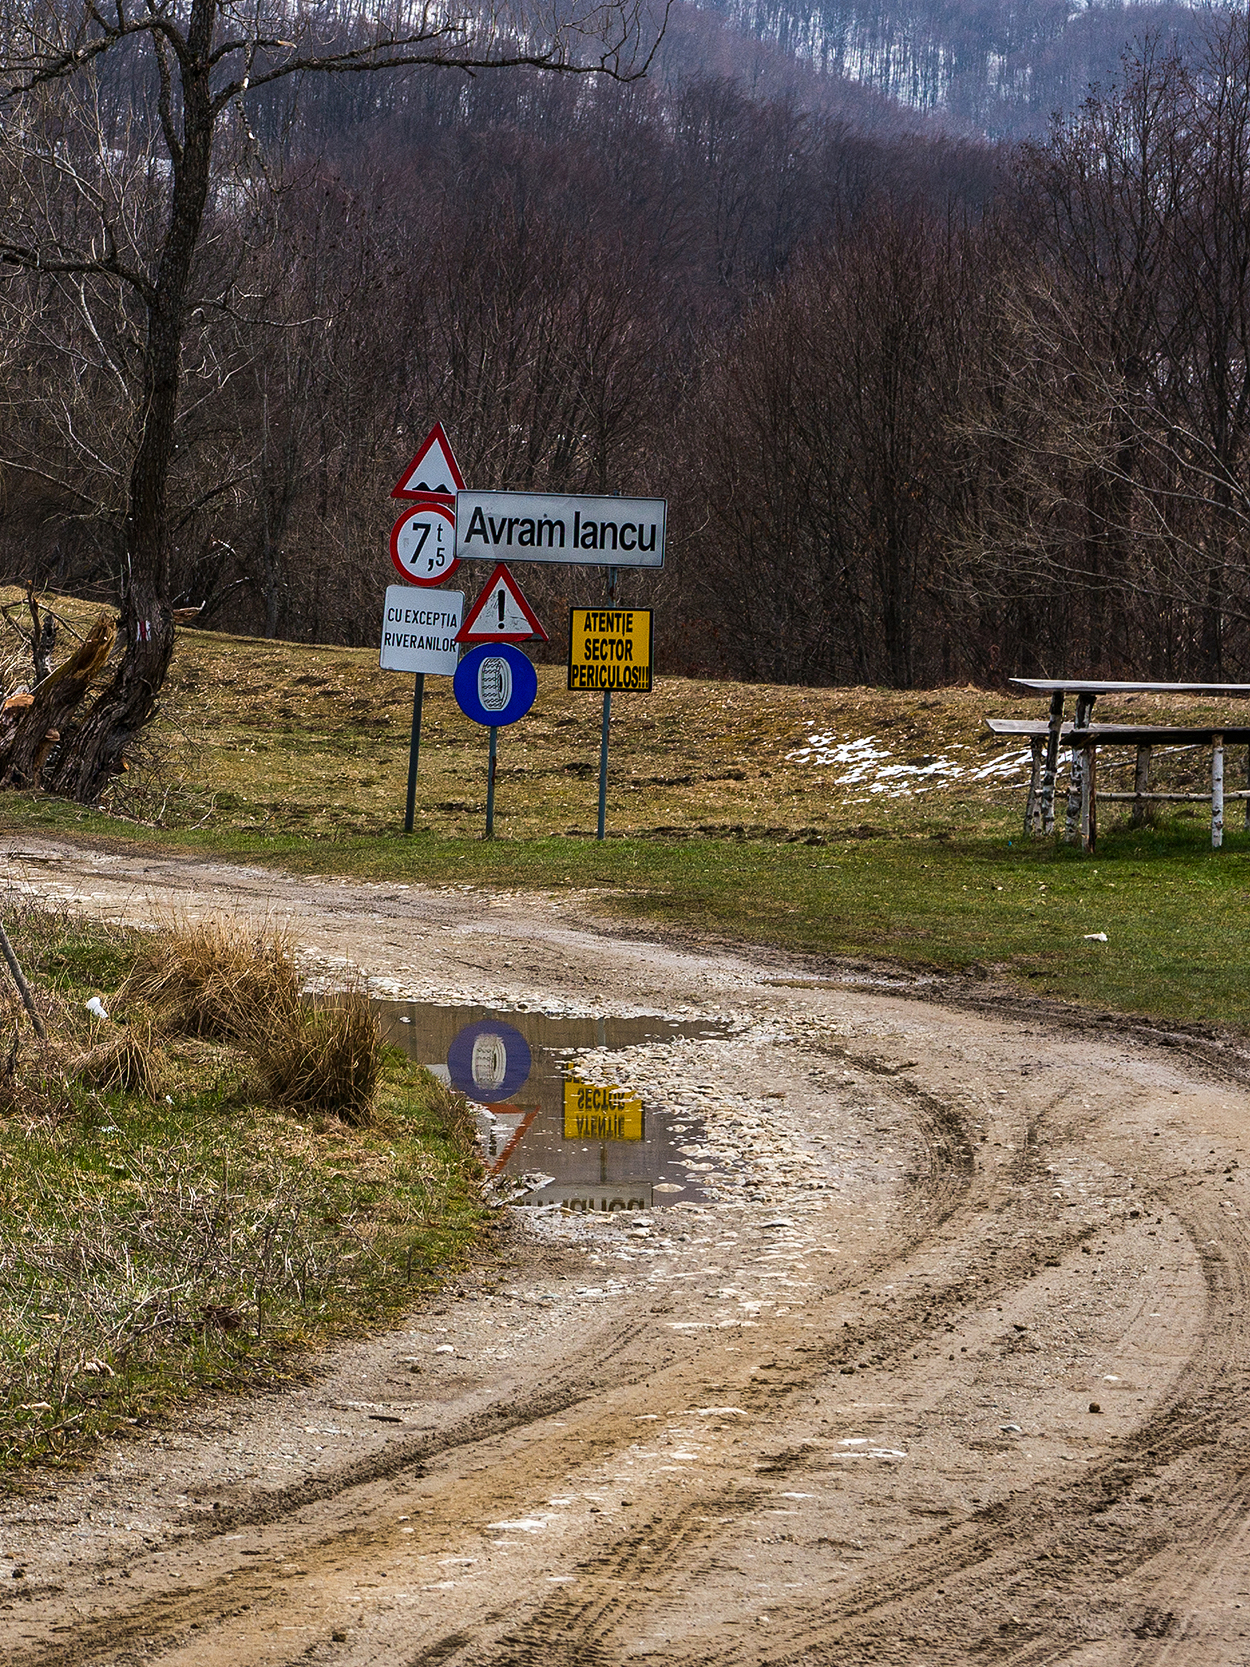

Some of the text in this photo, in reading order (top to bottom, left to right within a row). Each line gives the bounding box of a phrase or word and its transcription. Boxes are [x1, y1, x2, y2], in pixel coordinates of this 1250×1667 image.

[464, 506, 656, 551] Avram Iancu
[387, 607, 403, 622] CU
[384, 632, 457, 652] RIVERANILOR
[584, 638, 633, 661] SECTOR
[571, 664, 648, 688] PERICULOS!!!
